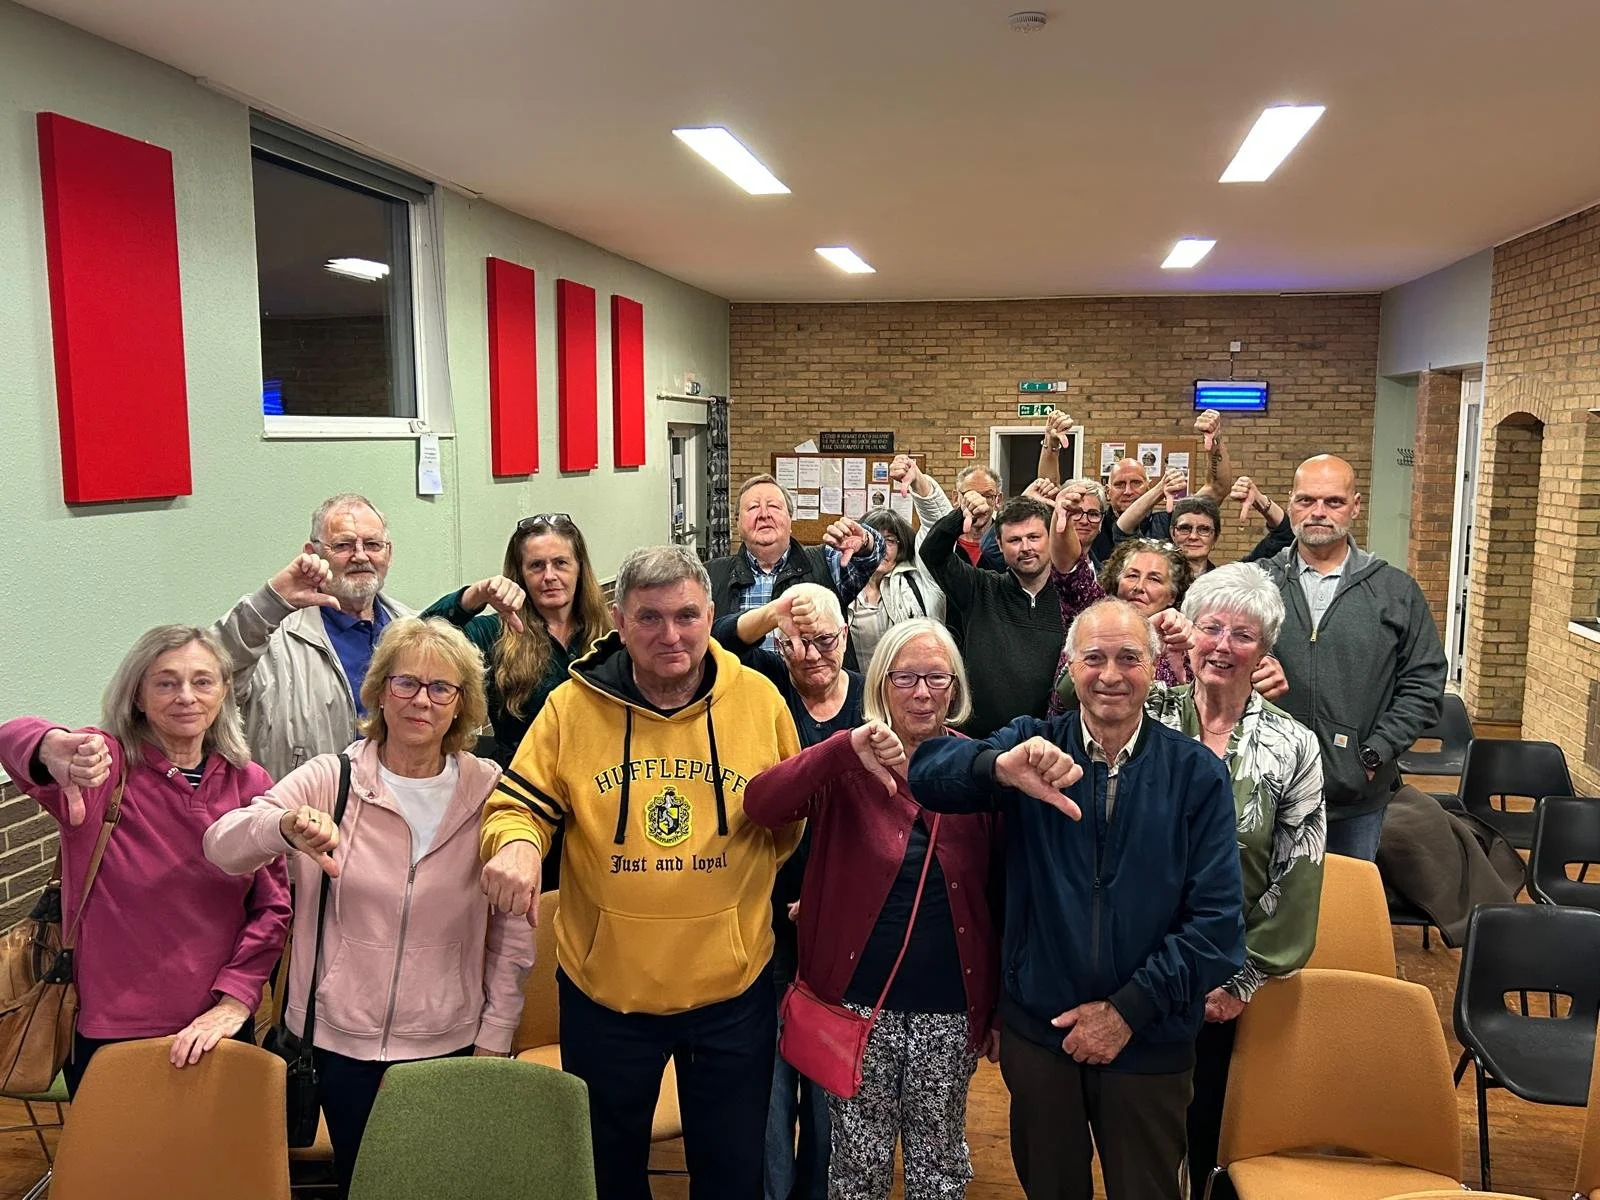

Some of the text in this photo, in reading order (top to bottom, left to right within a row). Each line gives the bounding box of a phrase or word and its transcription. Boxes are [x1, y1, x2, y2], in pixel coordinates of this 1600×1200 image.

[610, 852, 728, 874] Just and loyal
